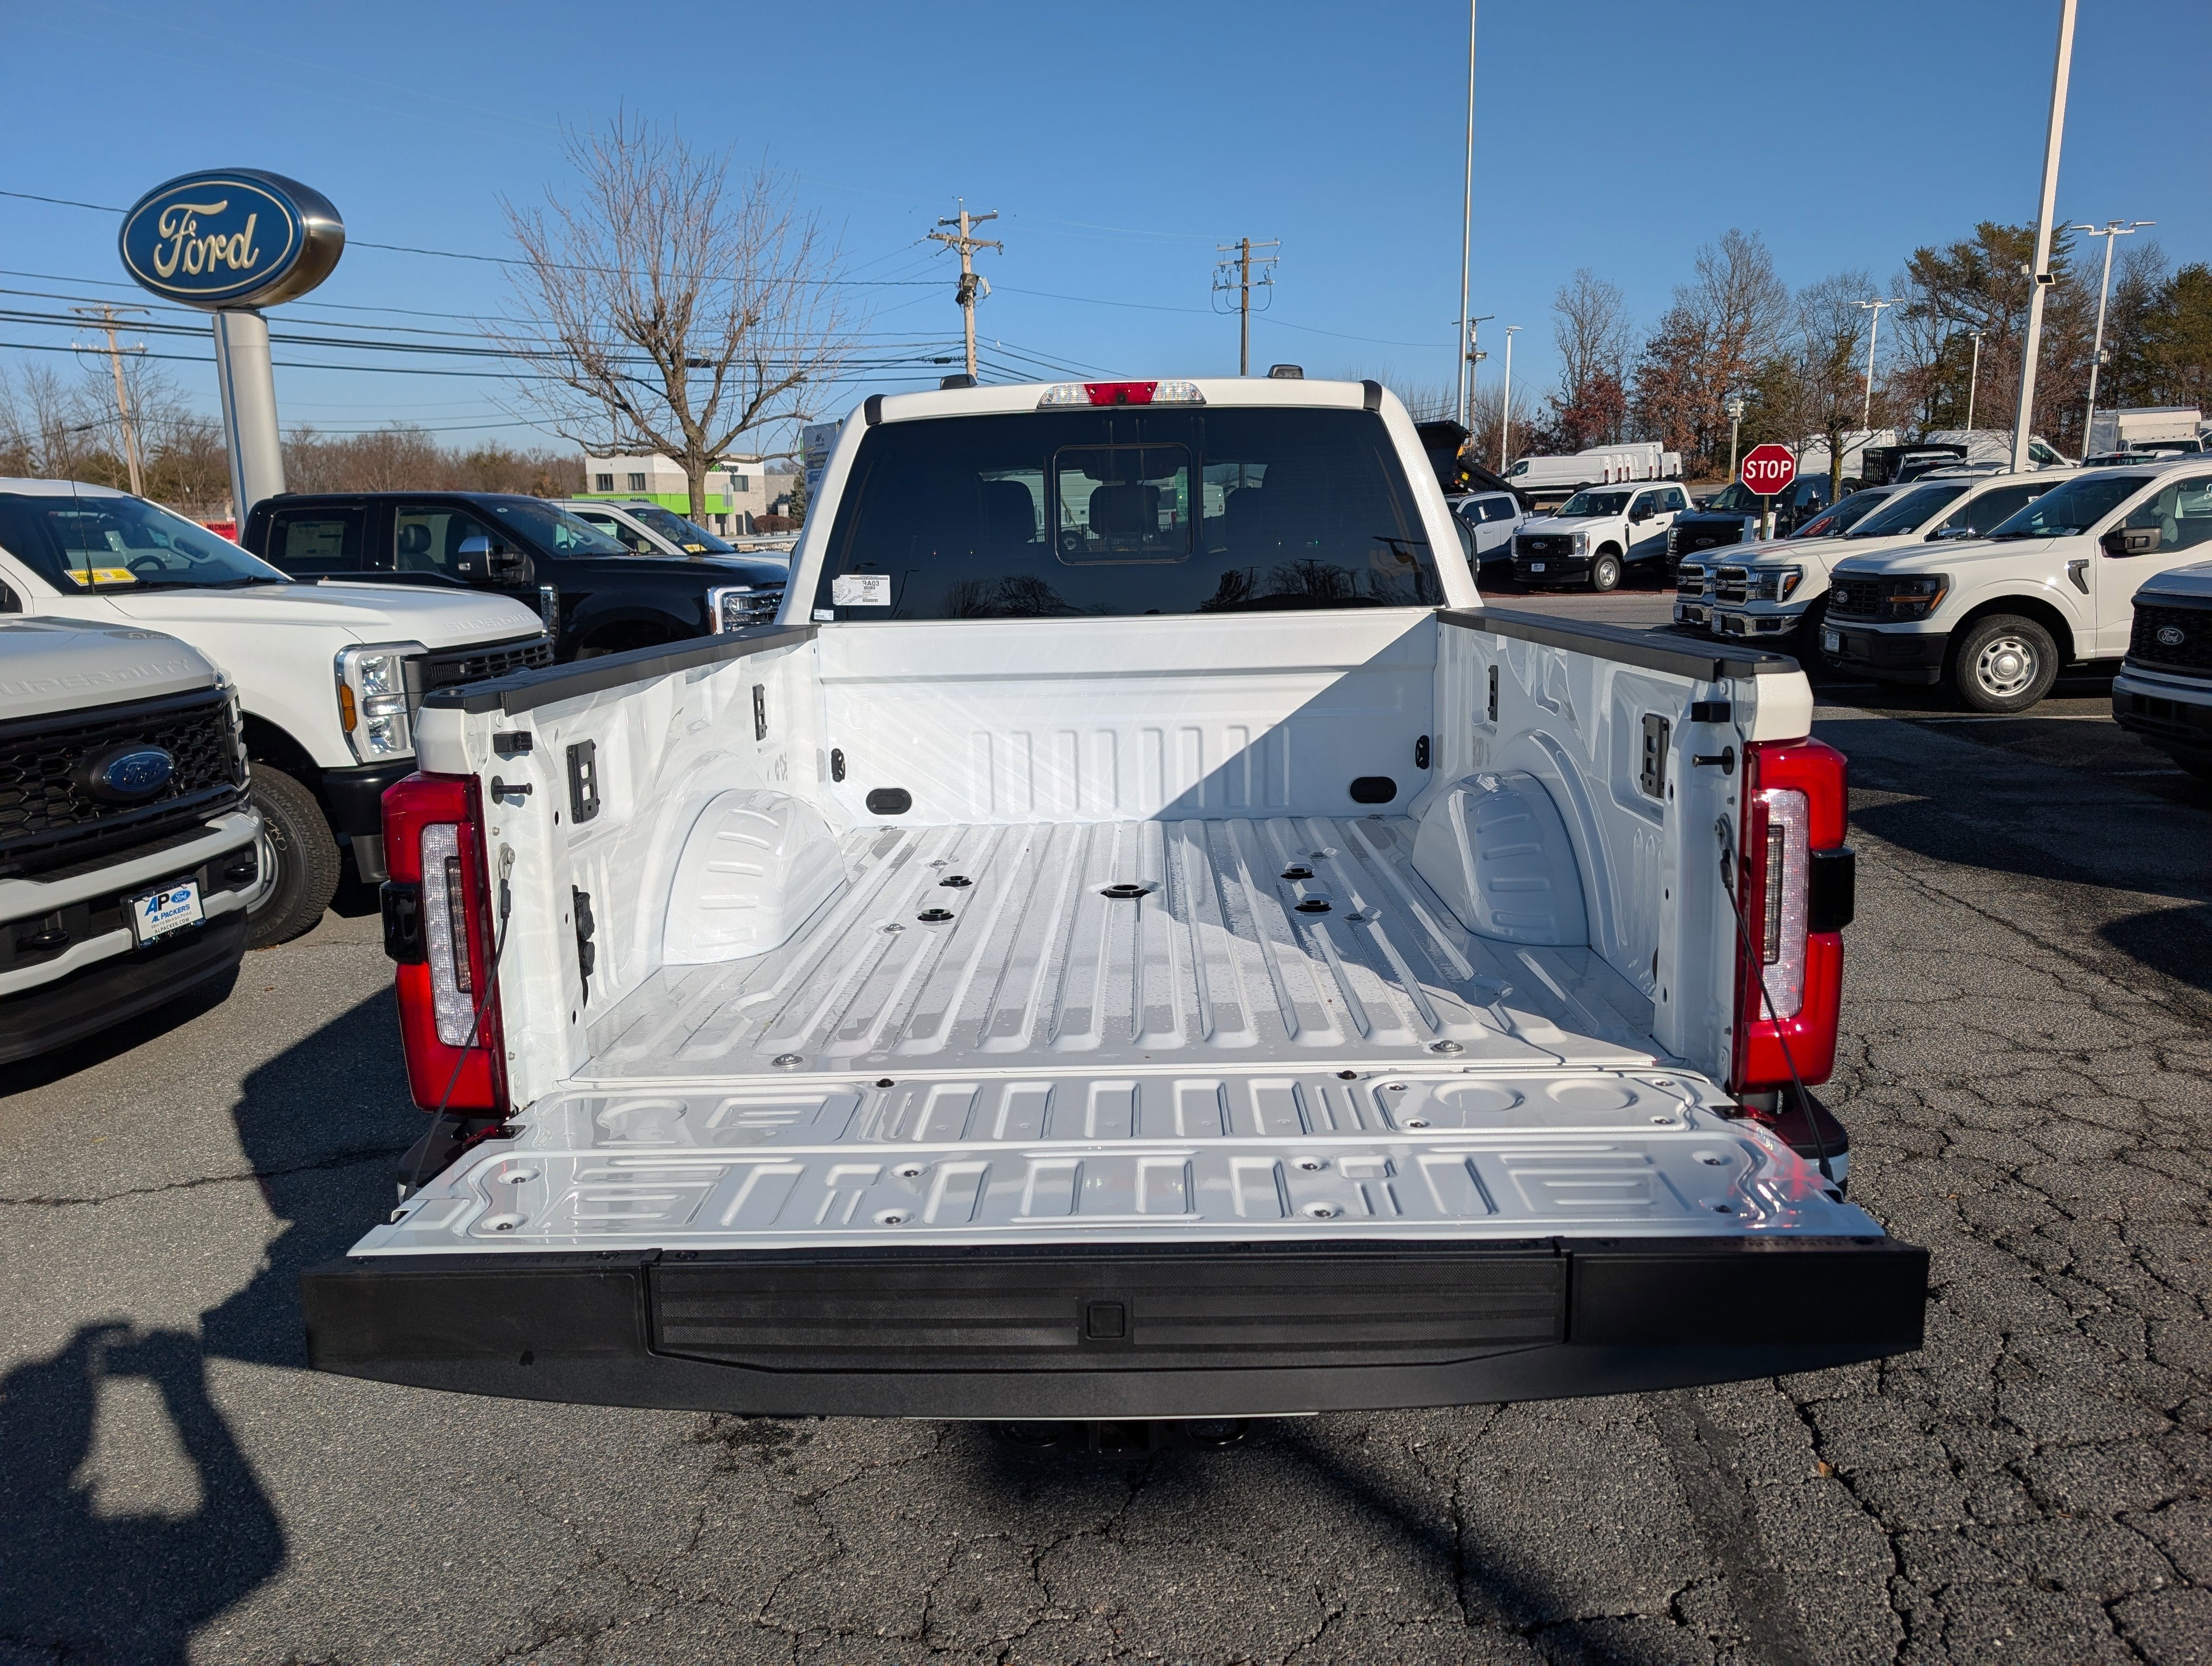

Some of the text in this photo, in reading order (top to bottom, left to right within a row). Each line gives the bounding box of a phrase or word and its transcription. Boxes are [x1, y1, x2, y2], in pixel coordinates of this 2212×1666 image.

[153, 200, 259, 278] Ford
[1746, 460, 1792, 479] STOP
[2162, 630, 2178, 642] Ford
[0, 659, 192, 696] UPER DUTY
[124, 760, 160, 785] Ford
[144, 892, 187, 917] AP Ford
[152, 904, 191, 924] AL PACKER'S
[155, 917, 190, 934] ALPACKER.COM
